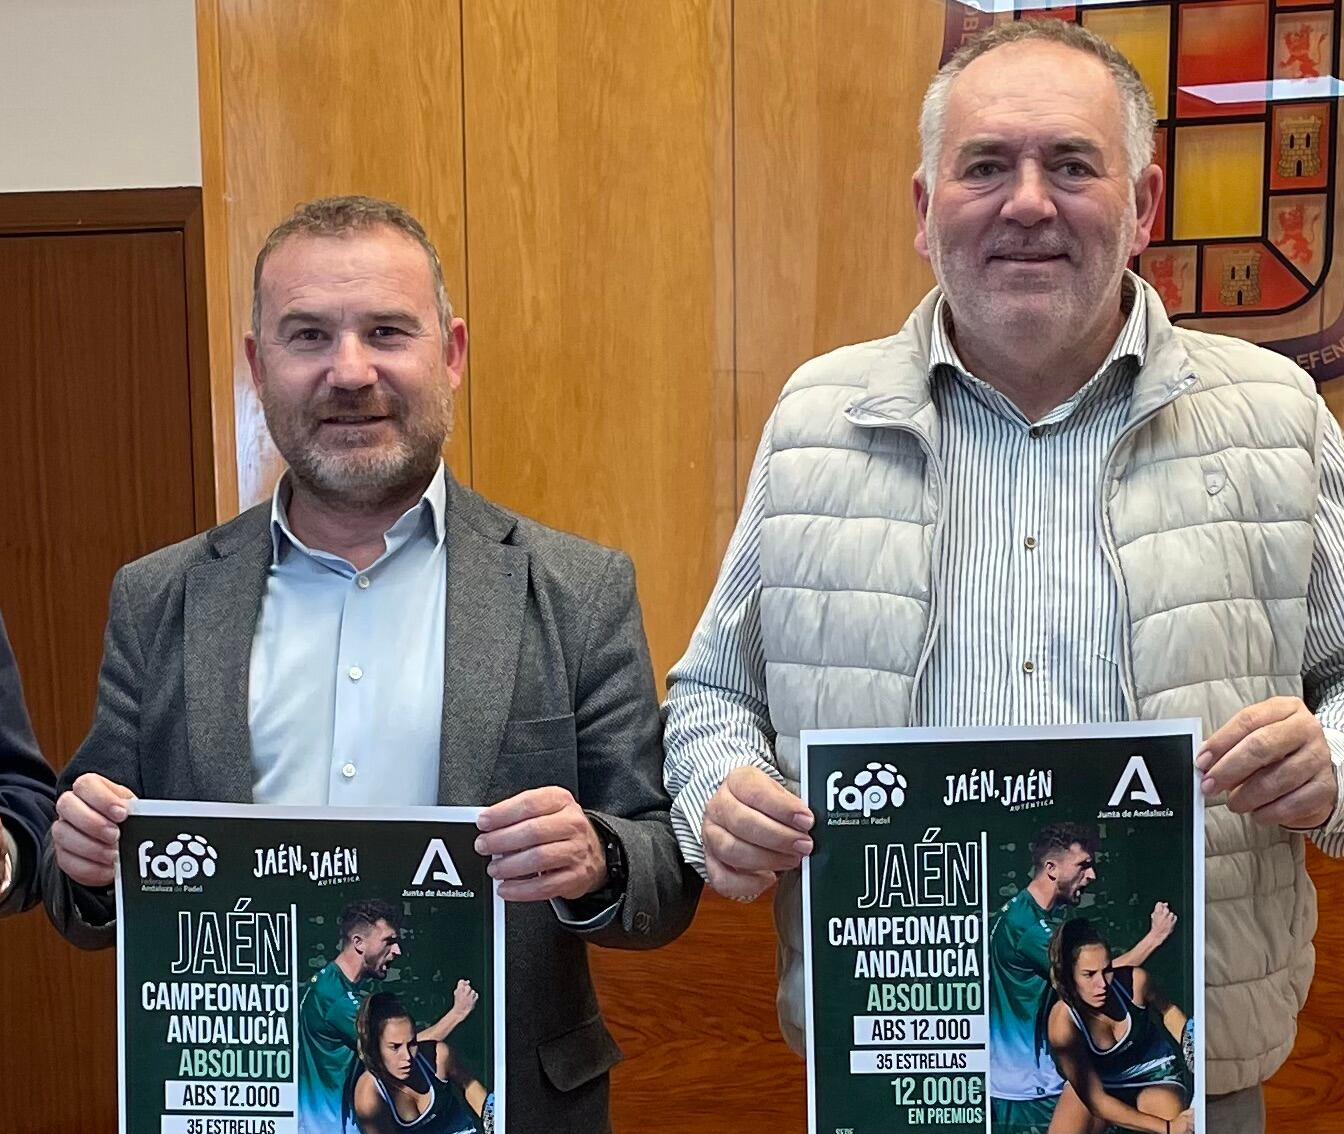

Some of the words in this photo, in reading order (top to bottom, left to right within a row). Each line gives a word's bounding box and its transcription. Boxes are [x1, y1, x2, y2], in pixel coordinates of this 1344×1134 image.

[826, 771, 887, 817] fap
[943, 768, 1000, 806] JAÉN,
[1001, 768, 1053, 806] JAÉN
[138, 840, 199, 885] fap
[253, 843, 308, 878] JAÉN,
[309, 846, 359, 881] JAÉN
[857, 827, 979, 909] JAÉN
[171, 897, 289, 976] JAÉN
[828, 914, 979, 946] CAMPEONATO
[854, 941, 980, 978] ANDALUCÍA
[141, 981, 290, 1012] CAMPEONATO
[866, 982, 981, 1012] ABSOLUTO
[166, 1010, 290, 1045] ANDALUCÍA
[871, 1018, 906, 1041] ABS
[910, 1018, 971, 1041] 12.000
[178, 1048, 291, 1079] ABSOLUTO
[876, 1053, 893, 1070] 35
[896, 1052, 967, 1070] ESTRELLAS
[182, 1084, 217, 1107] ABS
[220, 1085, 280, 1108] 12.000
[891, 1076, 982, 1106] 12.000€
[186, 1118, 203, 1134] 35
[908, 1108, 925, 1125] EN
[928, 1106, 983, 1124] PREMIOS
